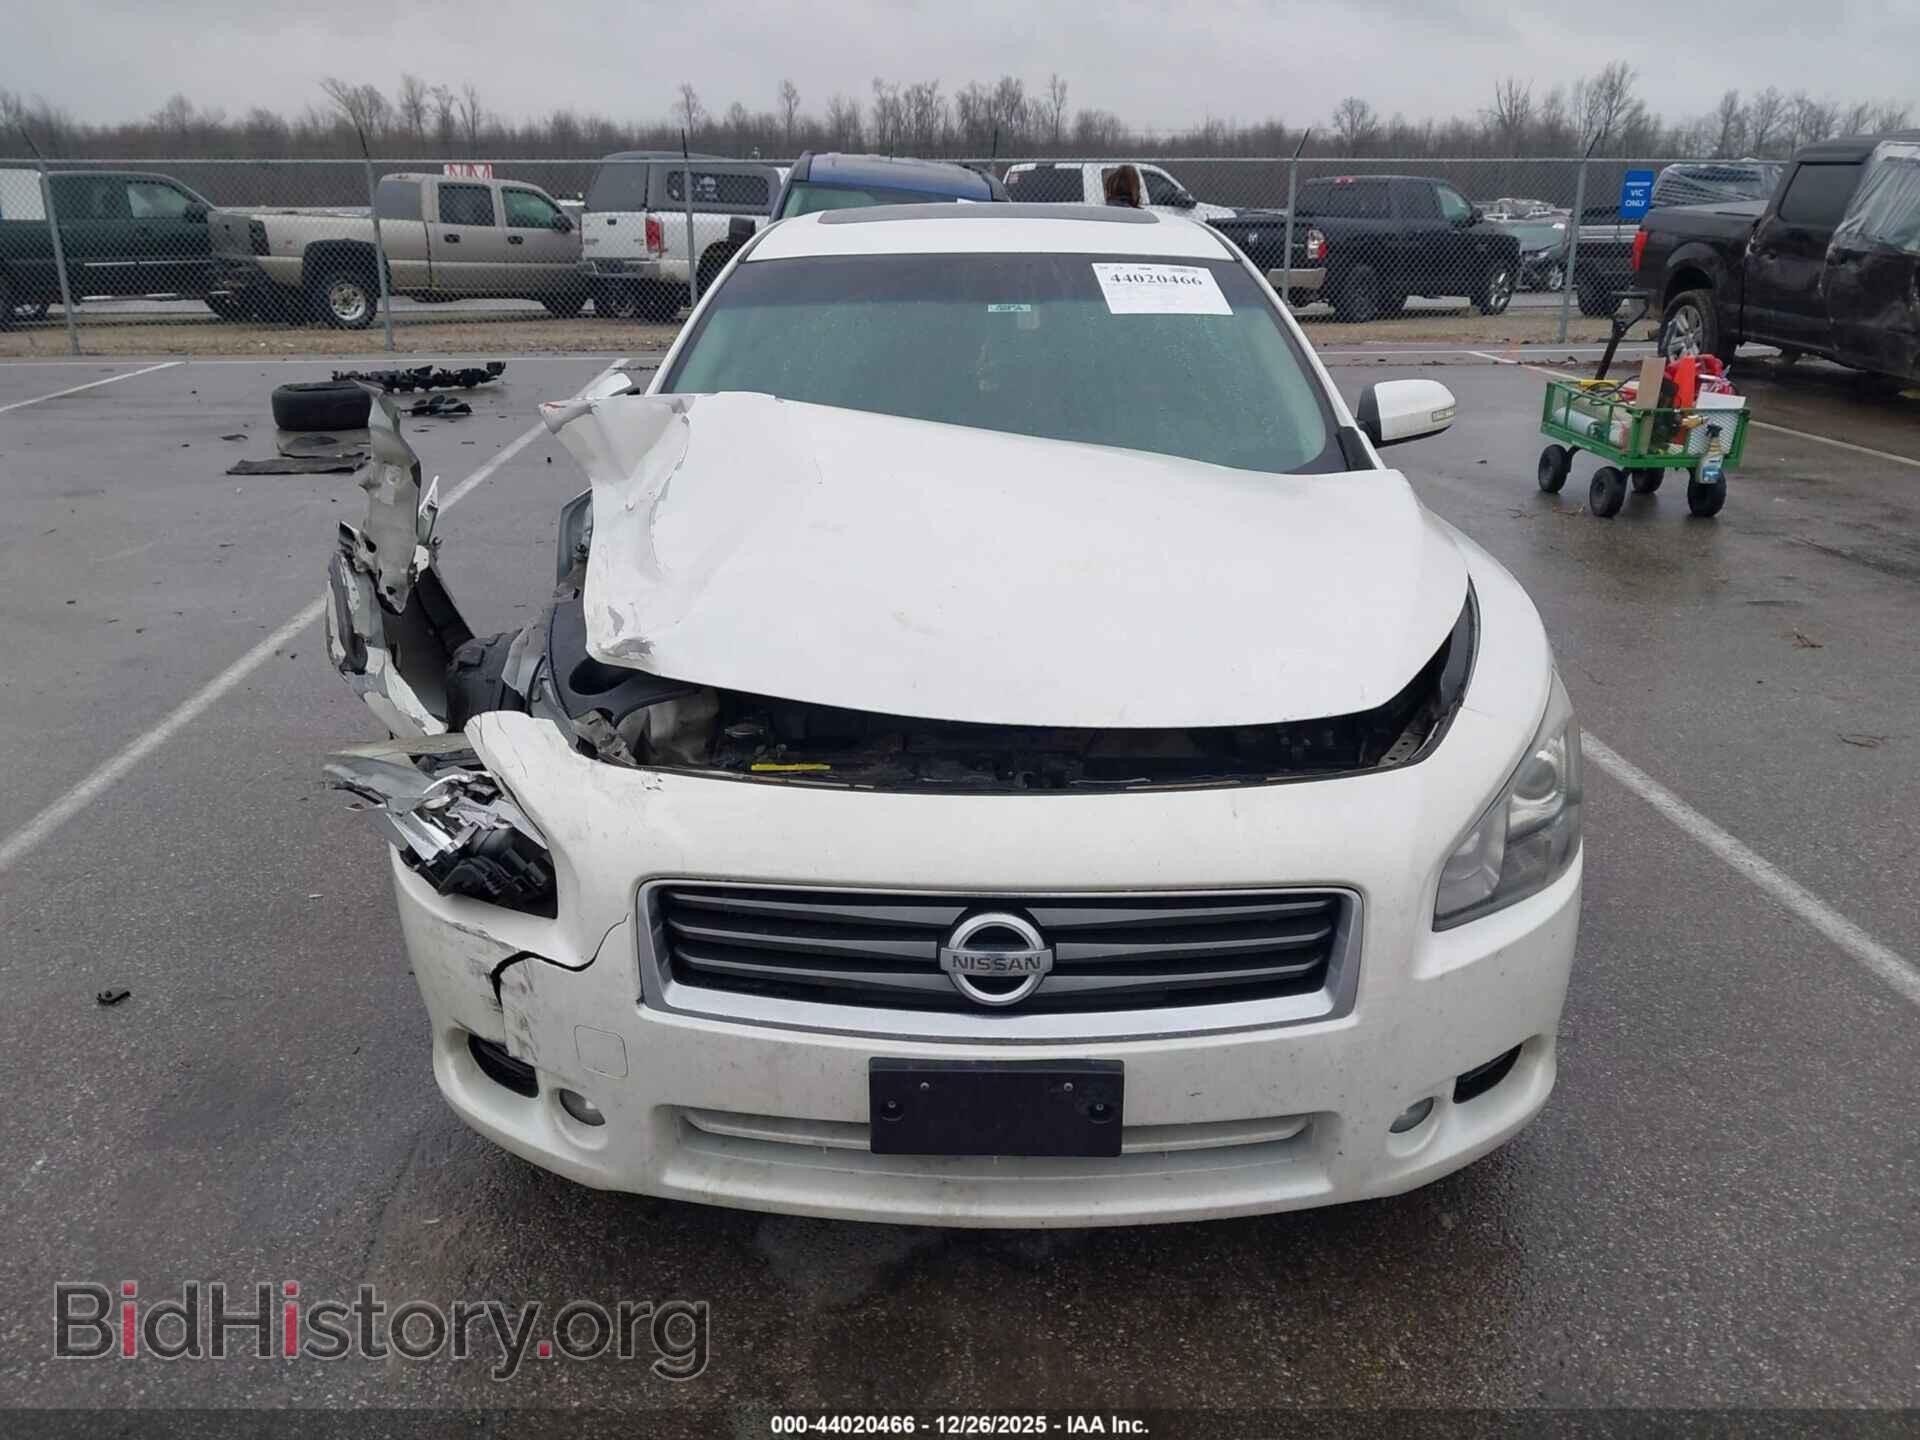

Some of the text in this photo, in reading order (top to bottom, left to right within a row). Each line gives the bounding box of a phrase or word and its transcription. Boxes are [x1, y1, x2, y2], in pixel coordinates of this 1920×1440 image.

[1630, 189, 1645, 197] VIC
[1624, 199, 1647, 207] ONLY
[1110, 272, 1203, 287] 44020466
[952, 955, 1041, 971] NISSAN
